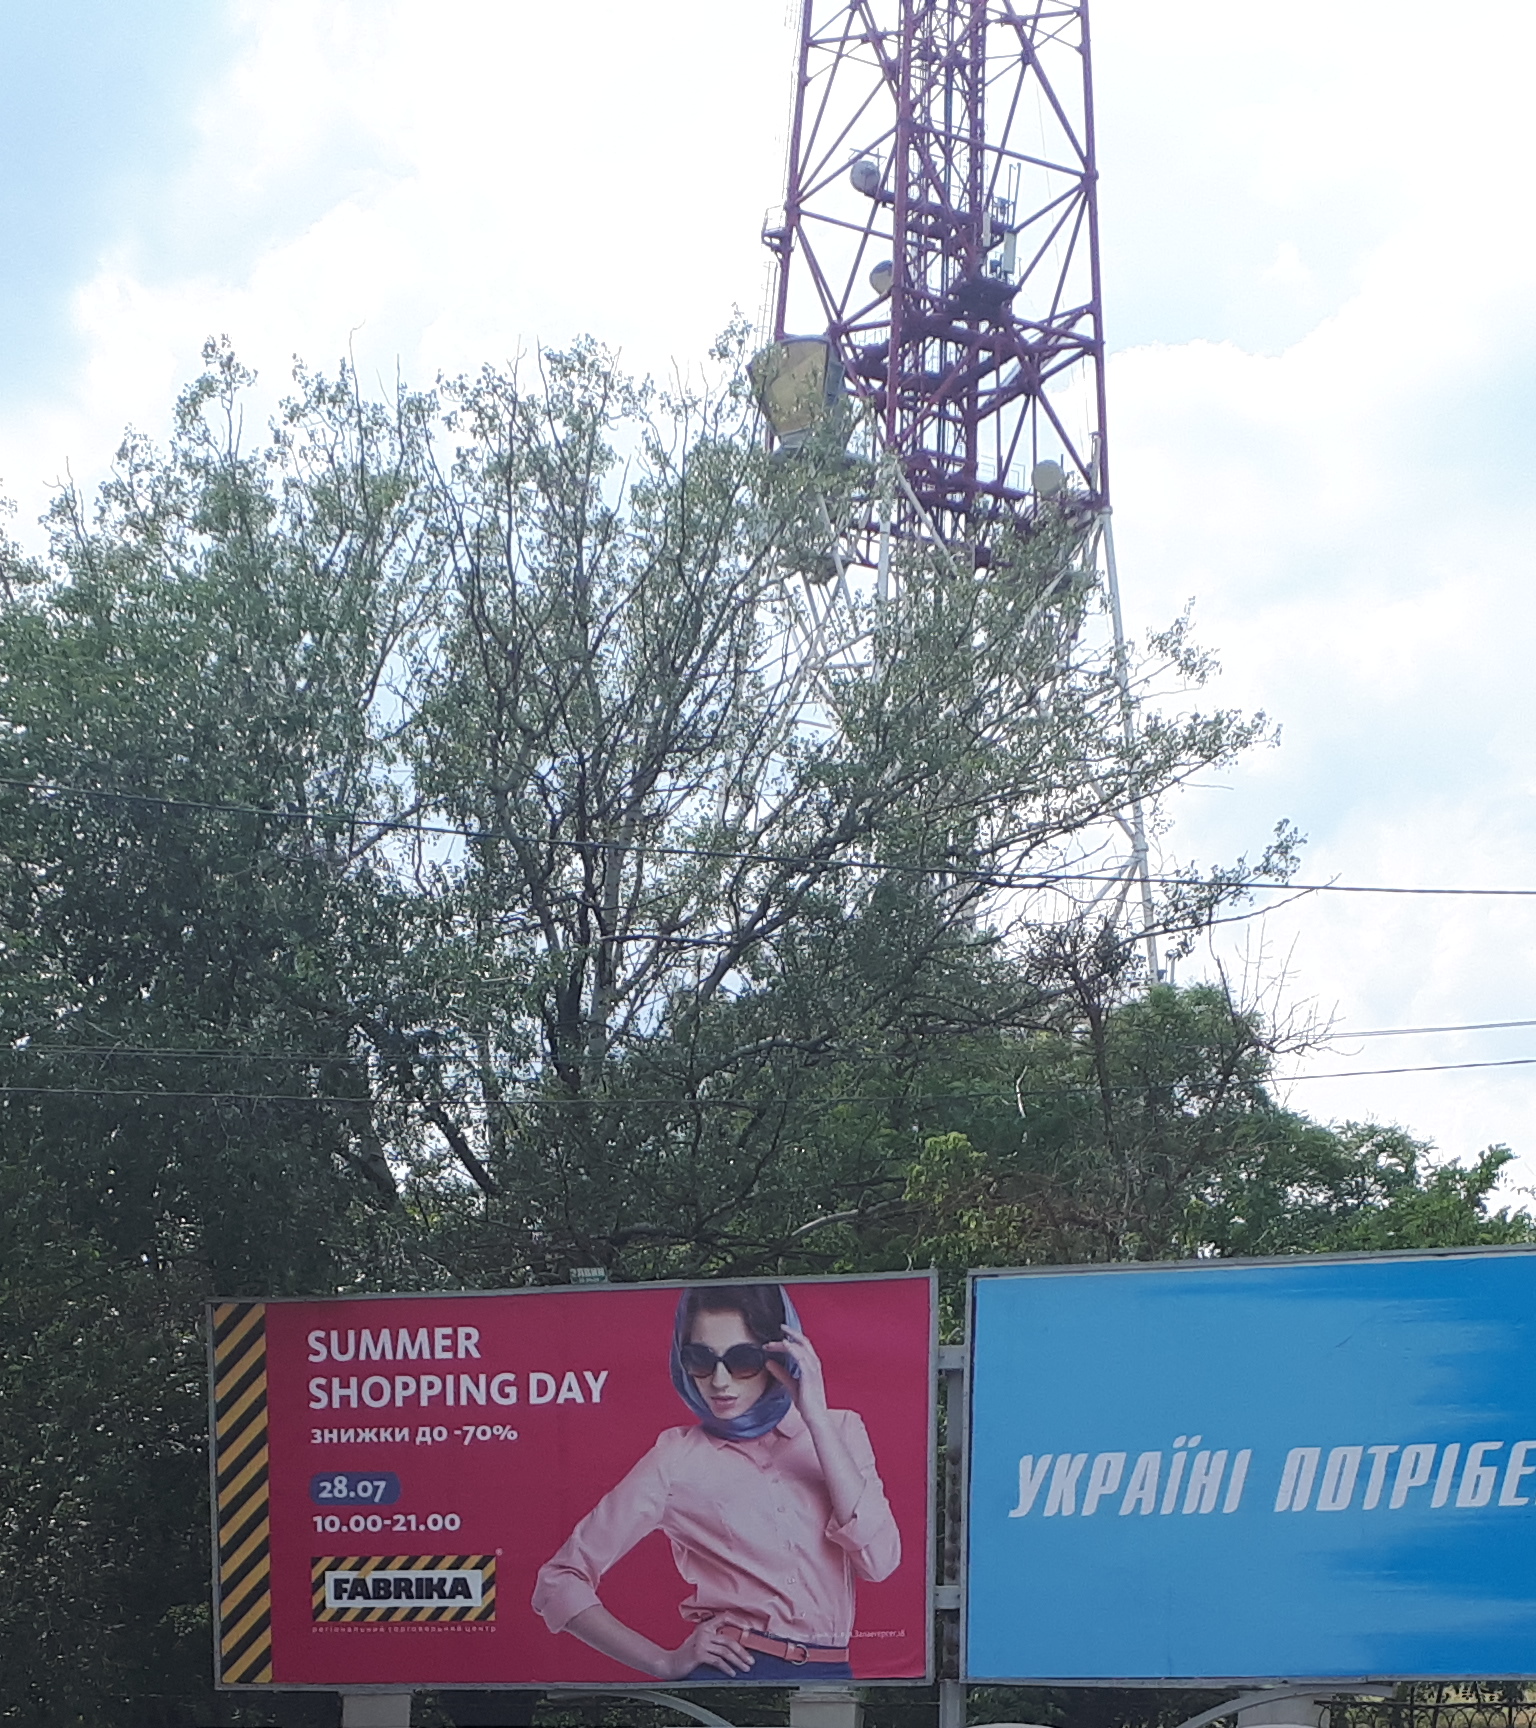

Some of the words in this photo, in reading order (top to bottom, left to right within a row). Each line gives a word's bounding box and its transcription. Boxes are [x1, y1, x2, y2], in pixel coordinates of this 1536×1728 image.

[307, 1326, 481, 1362] SUMMER
[308, 1372, 517, 1409] SHOPPING
[528, 1370, 609, 1405] DAY
[310, 1426, 410, 1444] знижки
[415, 1426, 448, 1445] до
[453, 1424, 518, 1446] -70%
[318, 1475, 387, 1503] 28.07
[1007, 1434, 1252, 1518] УКРАЇНІ
[312, 1513, 462, 1533] 10.00-21.00
[333, 1576, 473, 1601] FABRIKA
[465, 1625, 497, 1633] центр
